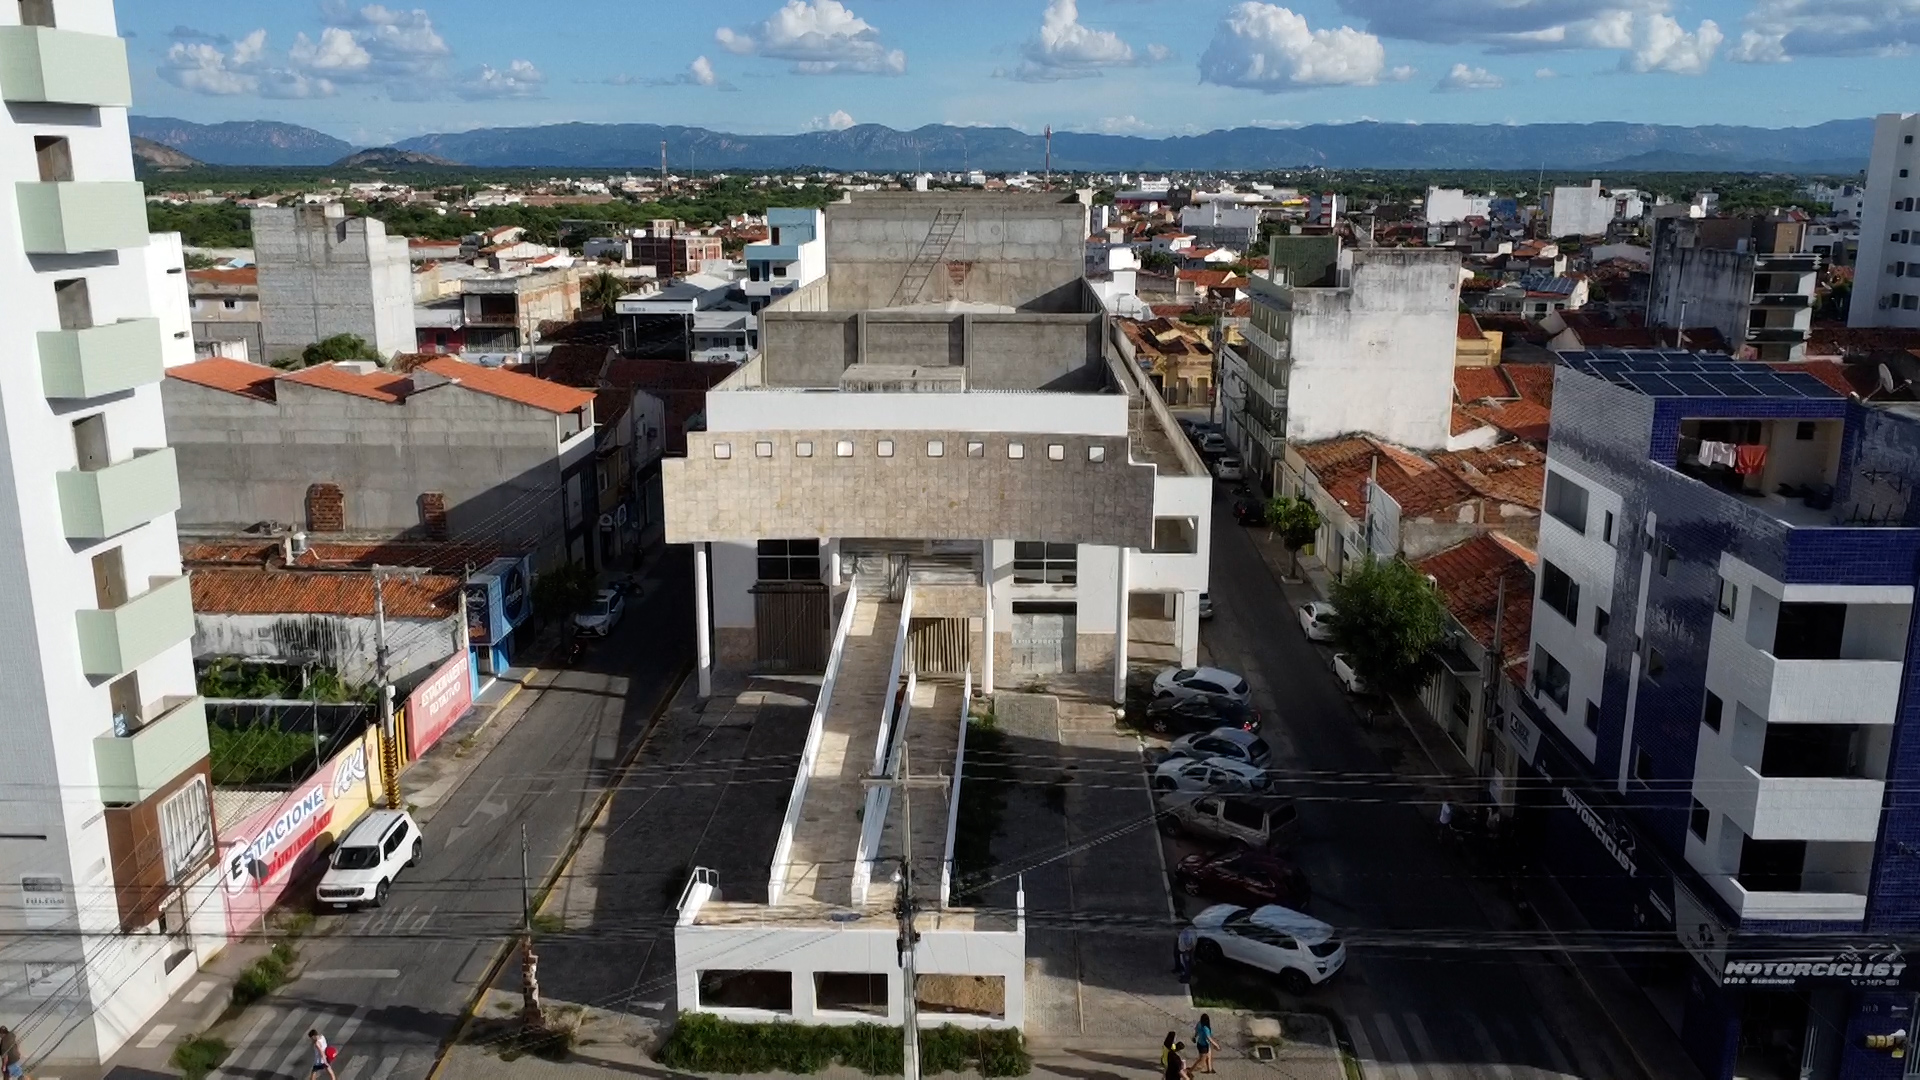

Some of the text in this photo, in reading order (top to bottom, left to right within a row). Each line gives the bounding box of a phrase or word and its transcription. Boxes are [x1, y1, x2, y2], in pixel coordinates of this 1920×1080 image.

[230, 788, 325, 882] ESTACIONE
[1561, 785, 1639, 878] MOTORCICLIST
[1724, 961, 1907, 977] MOTORCICLIST
